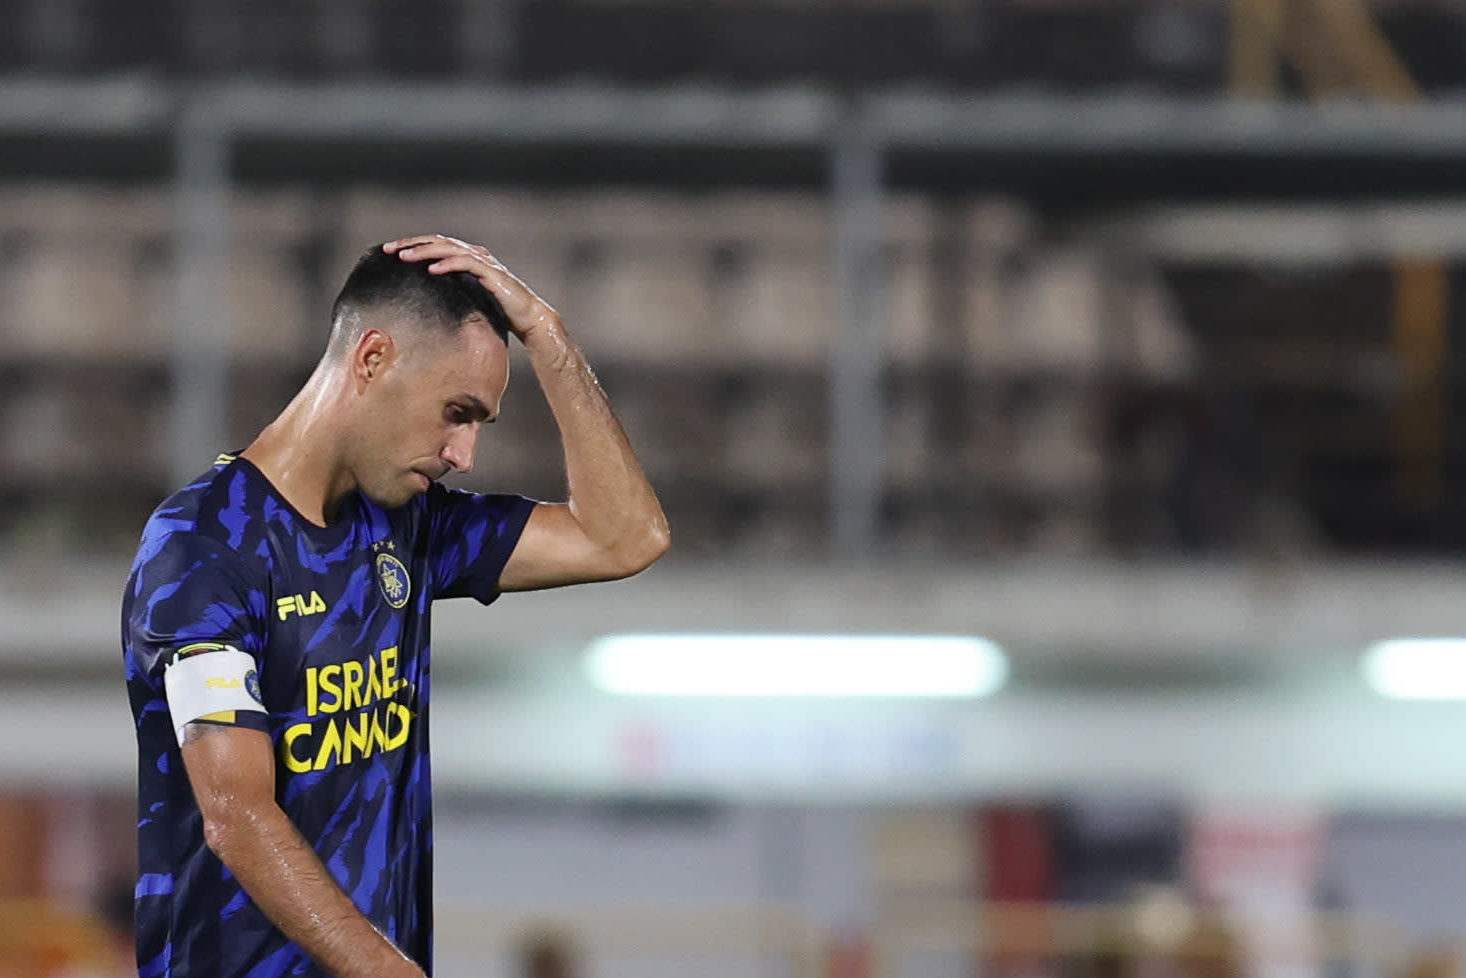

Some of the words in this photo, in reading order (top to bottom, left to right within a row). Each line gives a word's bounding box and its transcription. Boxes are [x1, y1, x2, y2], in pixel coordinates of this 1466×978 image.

[277, 591, 327, 621] FILA
[306, 646, 408, 717] ISRAE
[284, 701, 413, 773] CANAD
